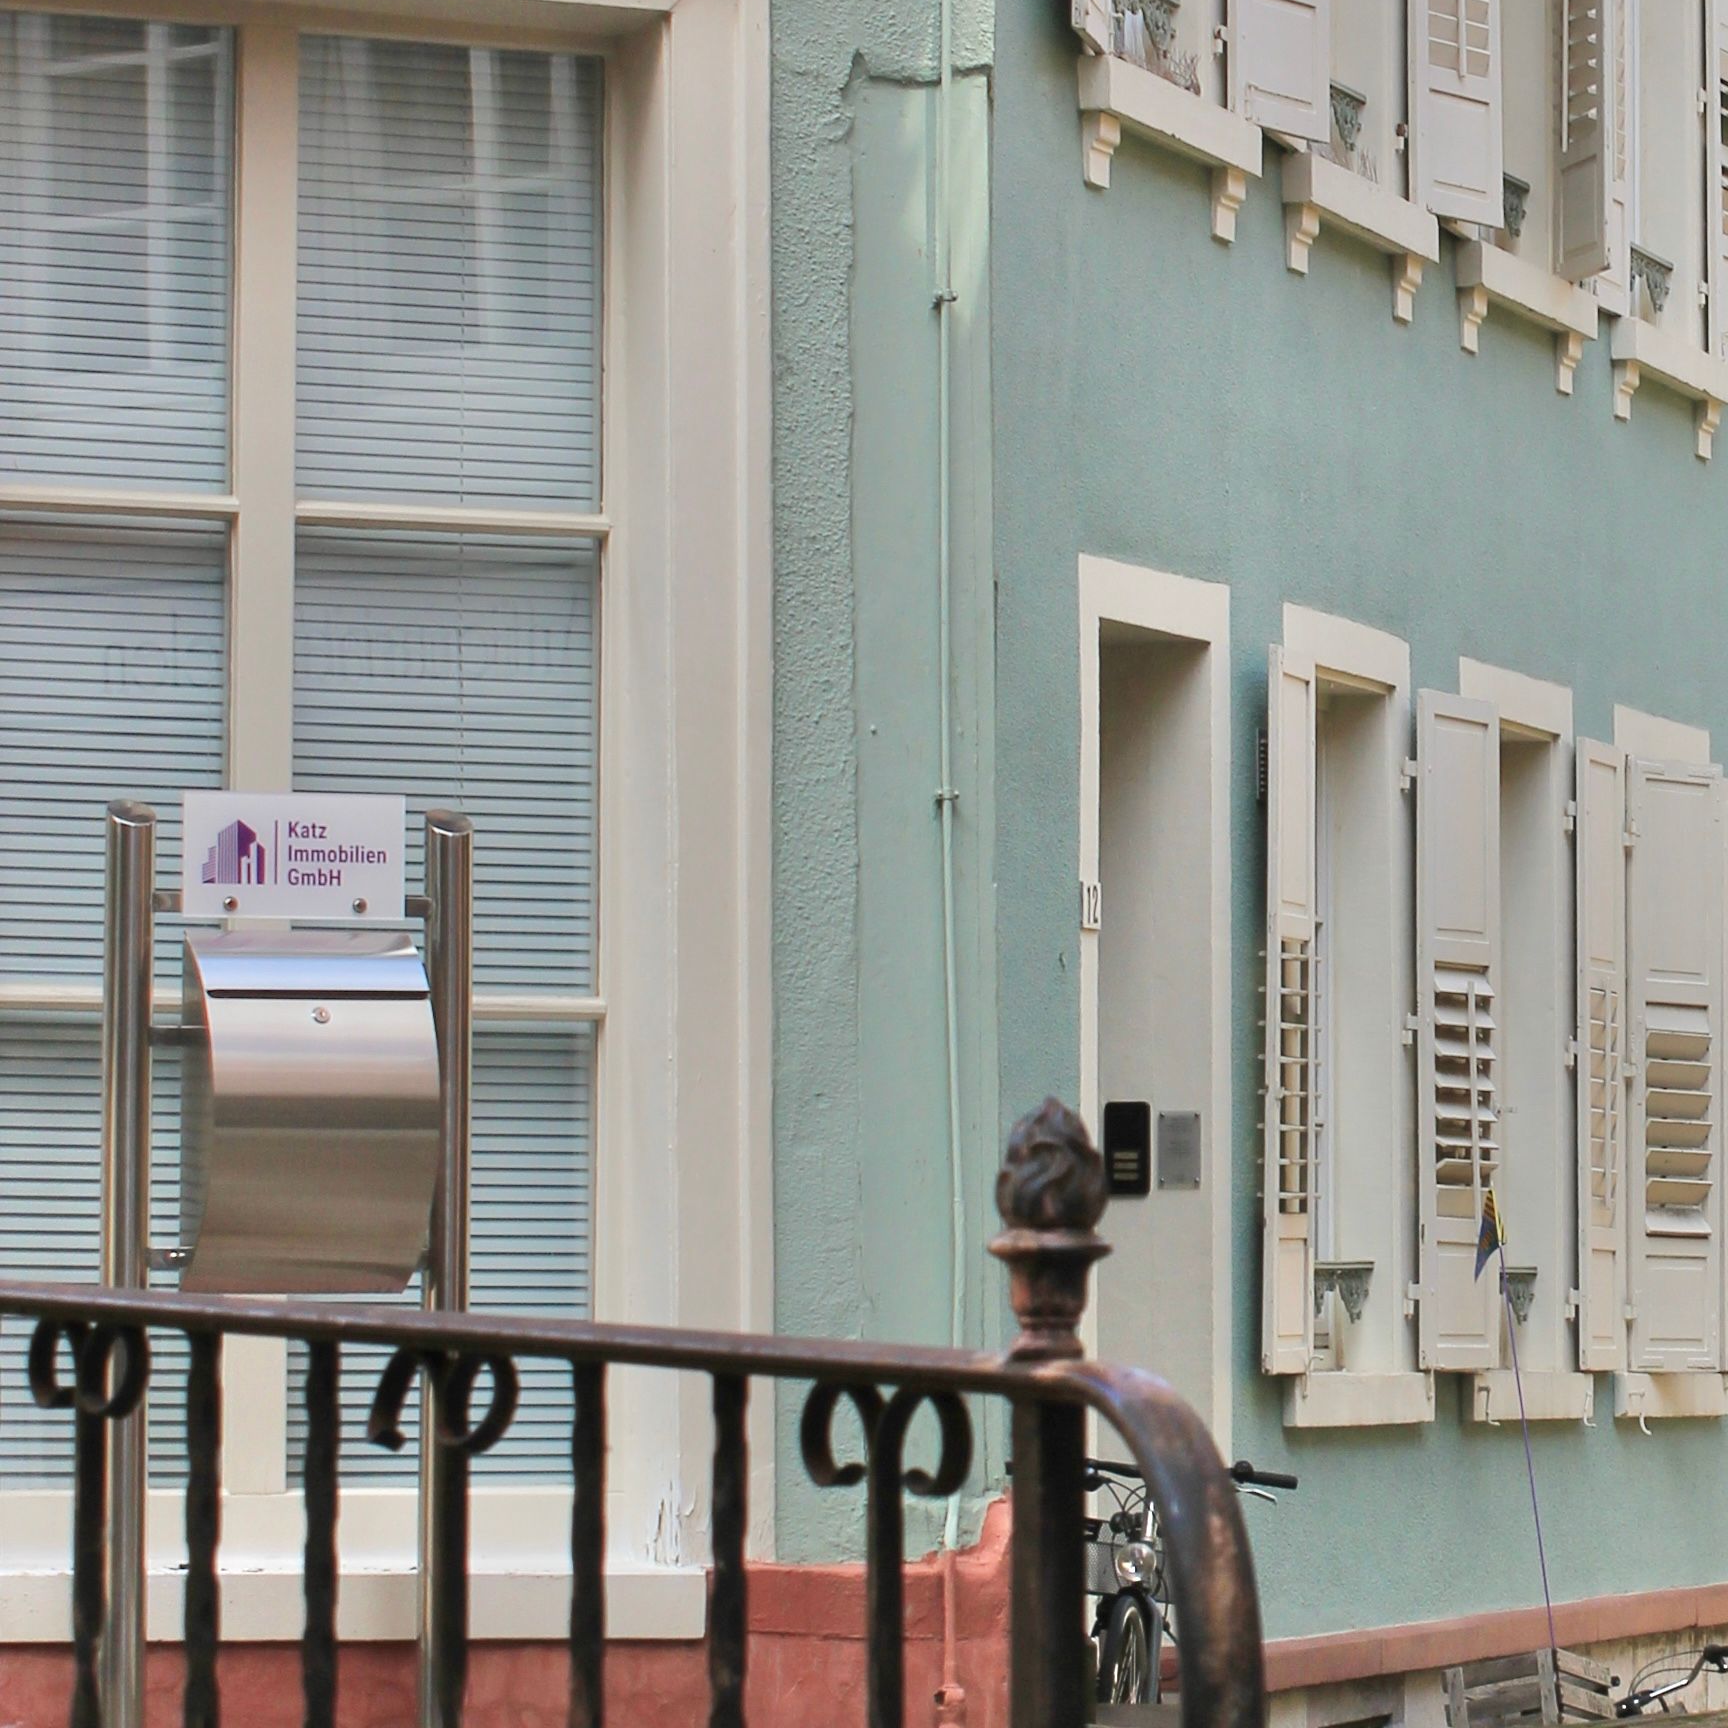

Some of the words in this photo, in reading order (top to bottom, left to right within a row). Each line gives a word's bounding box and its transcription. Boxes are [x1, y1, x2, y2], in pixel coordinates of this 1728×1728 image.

[288, 821, 327, 839] Katz
[288, 845, 387, 864] Immobilien
[288, 869, 341, 886] GmbH
[1087, 885, 1099, 924] 12
